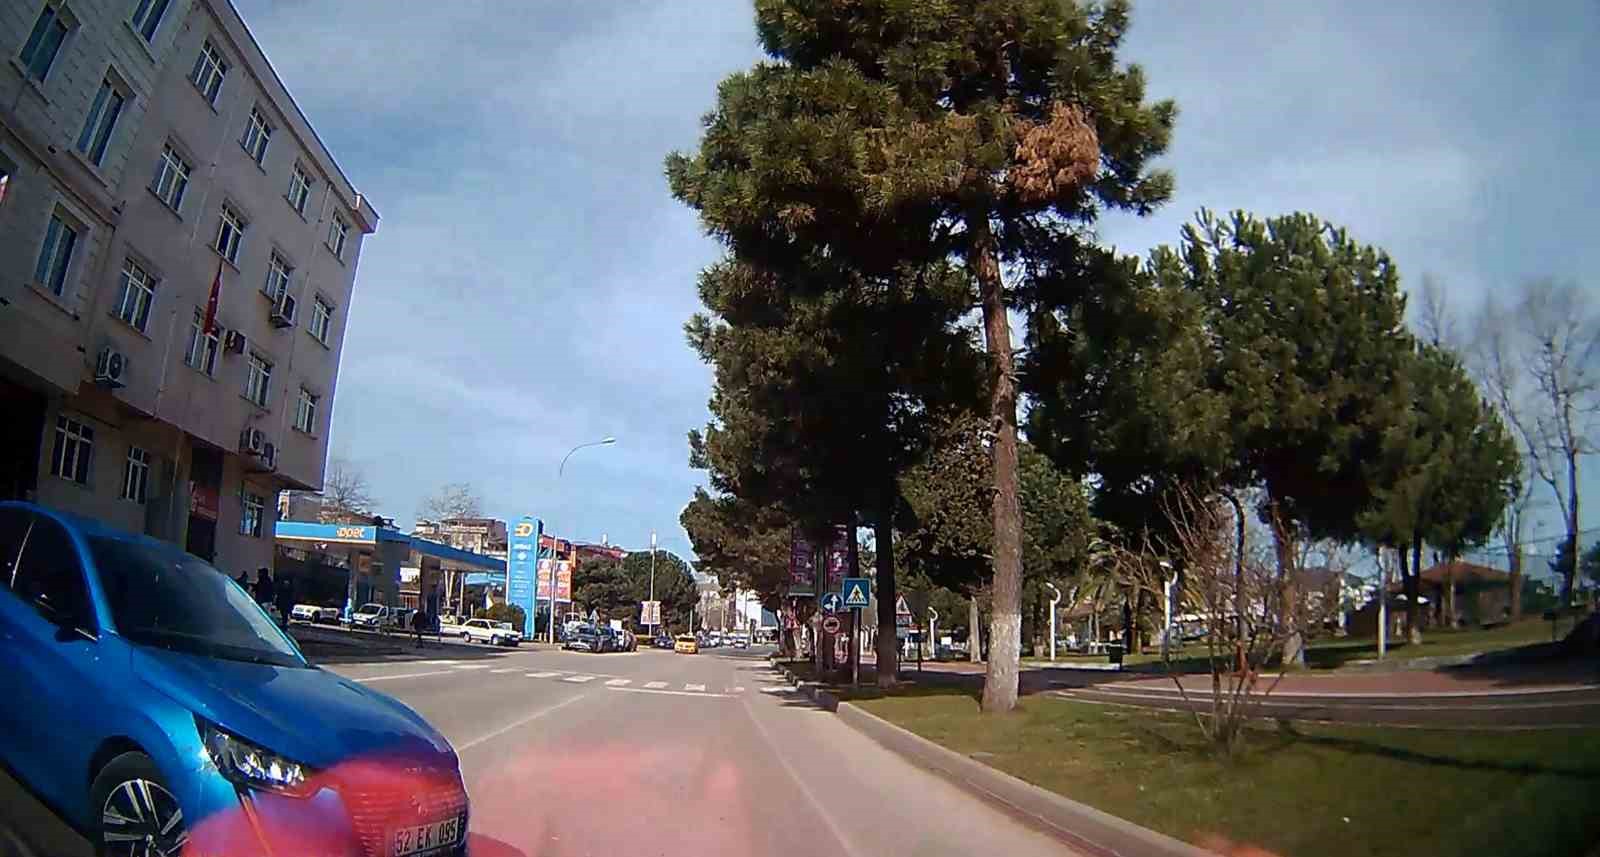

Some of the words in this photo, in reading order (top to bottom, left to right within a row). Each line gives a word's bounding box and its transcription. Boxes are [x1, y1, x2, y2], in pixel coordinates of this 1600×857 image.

[396, 830, 411, 854] 52
[417, 825, 432, 849] EK
[439, 820, 456, 843] 095
